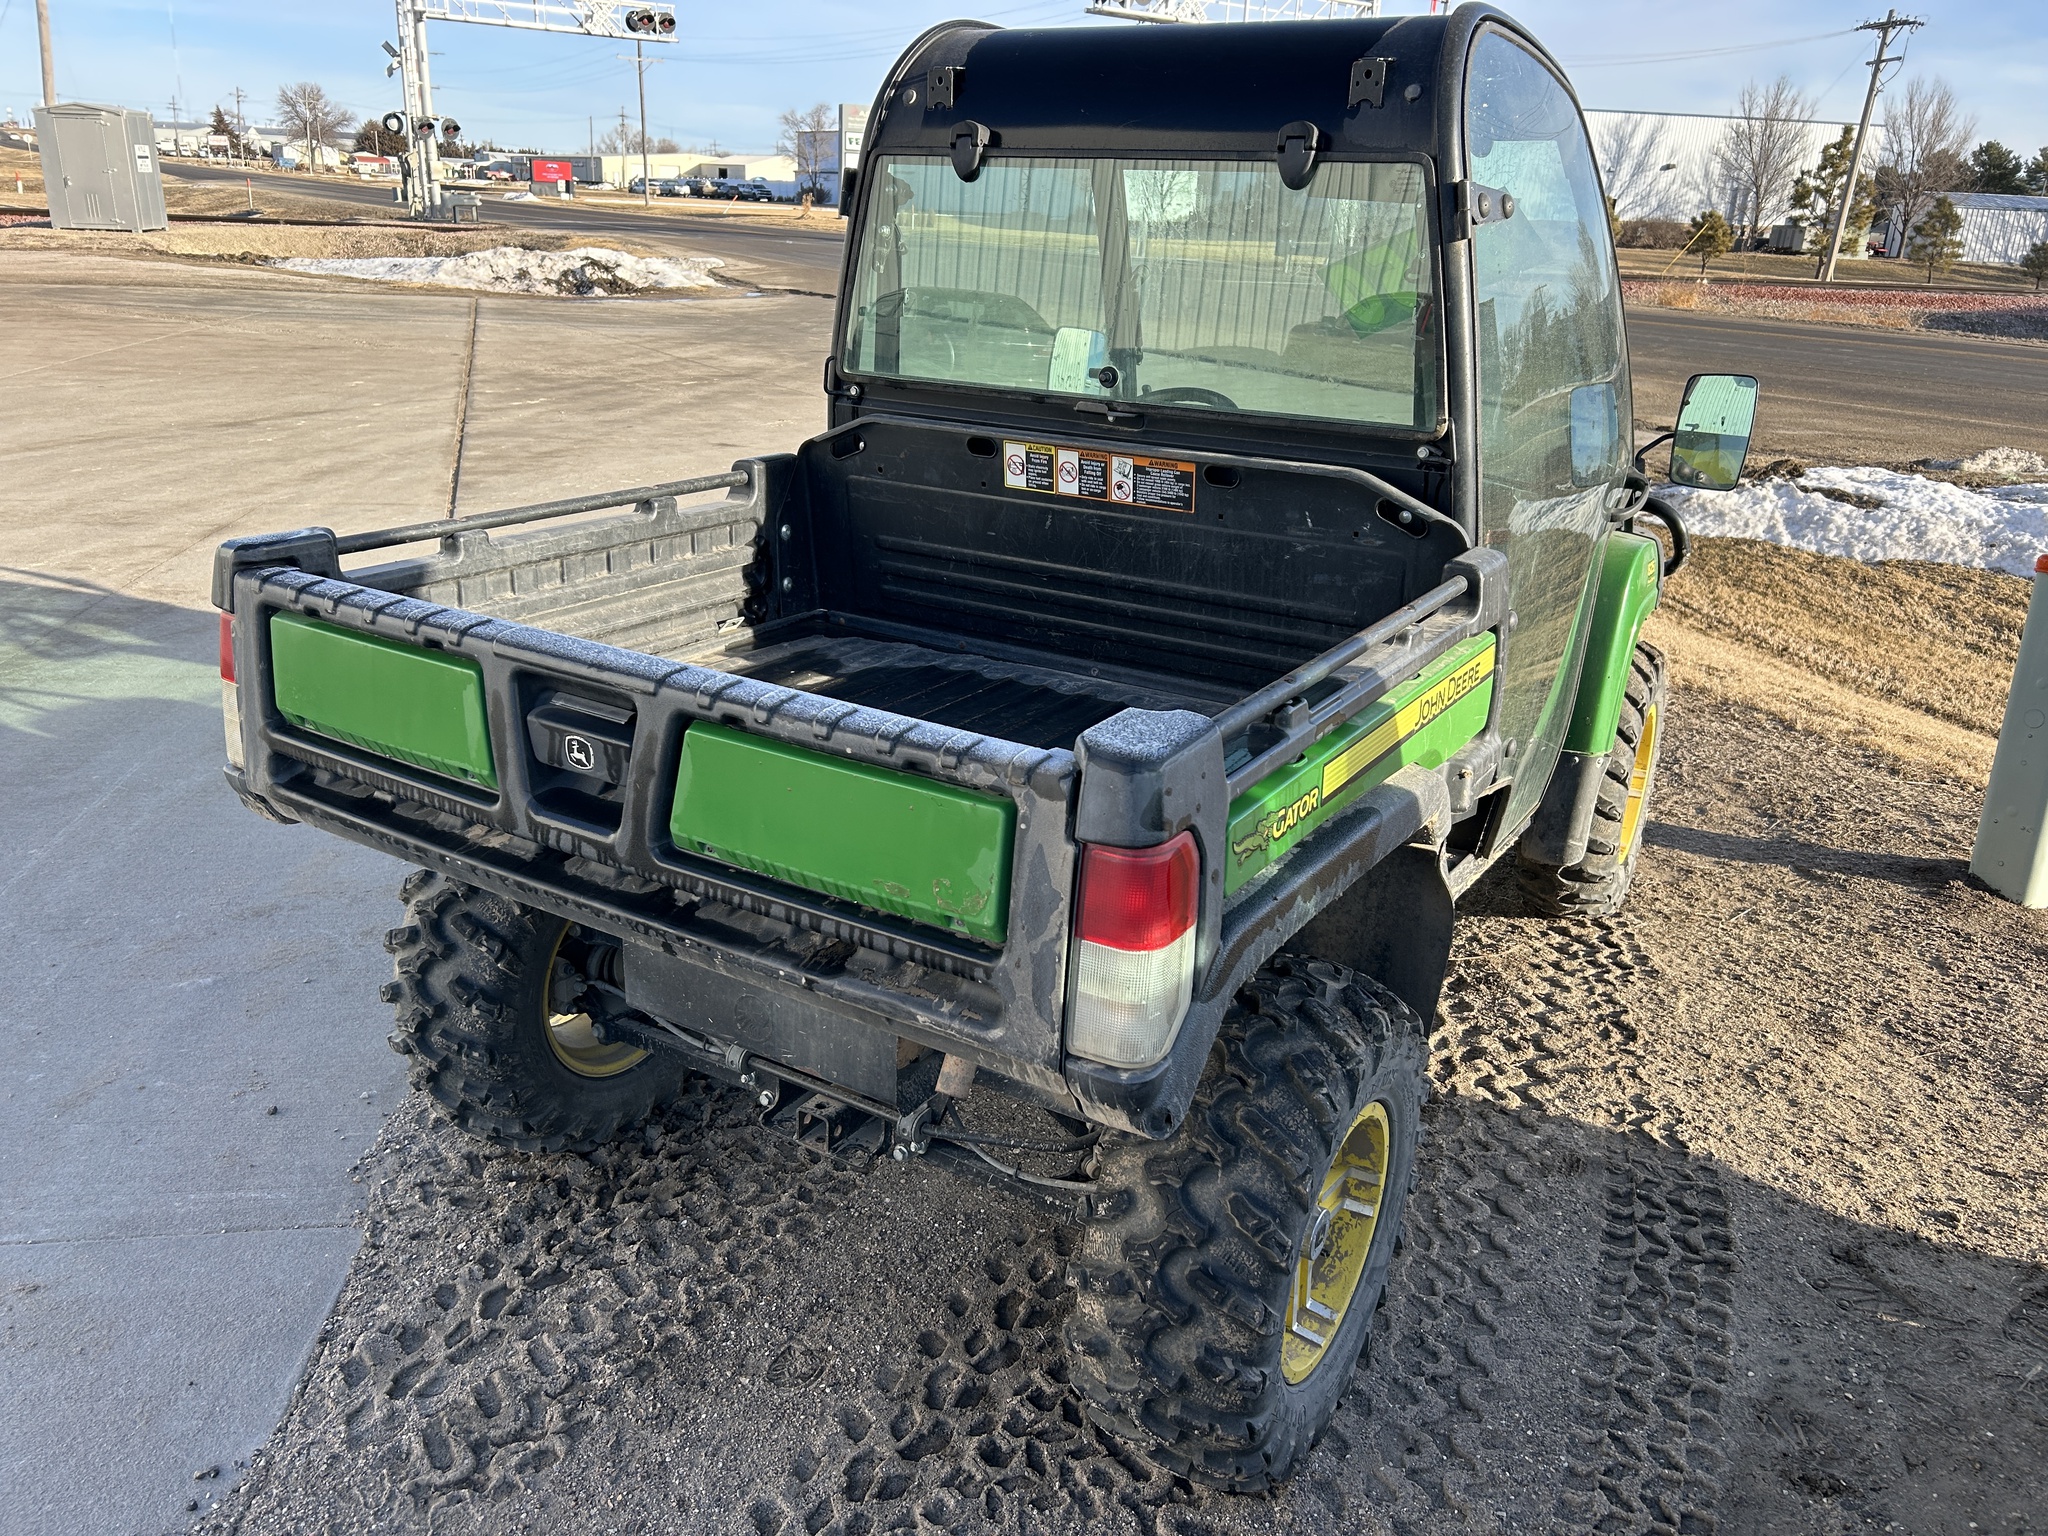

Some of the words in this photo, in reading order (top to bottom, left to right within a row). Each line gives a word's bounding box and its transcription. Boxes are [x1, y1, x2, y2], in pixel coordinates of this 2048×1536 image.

[590, 2, 615, 32] CROSSING
[604, 18, 616, 34] ROAD
[1033, 445, 1052, 453] CAUTION
[1085, 451, 1108, 460] WARNING
[1154, 460, 1178, 469] WARNING
[1414, 688, 1446, 728] JOHN
[1448, 661, 1481, 702] DEERE
[1271, 786, 1320, 841] GATOR
